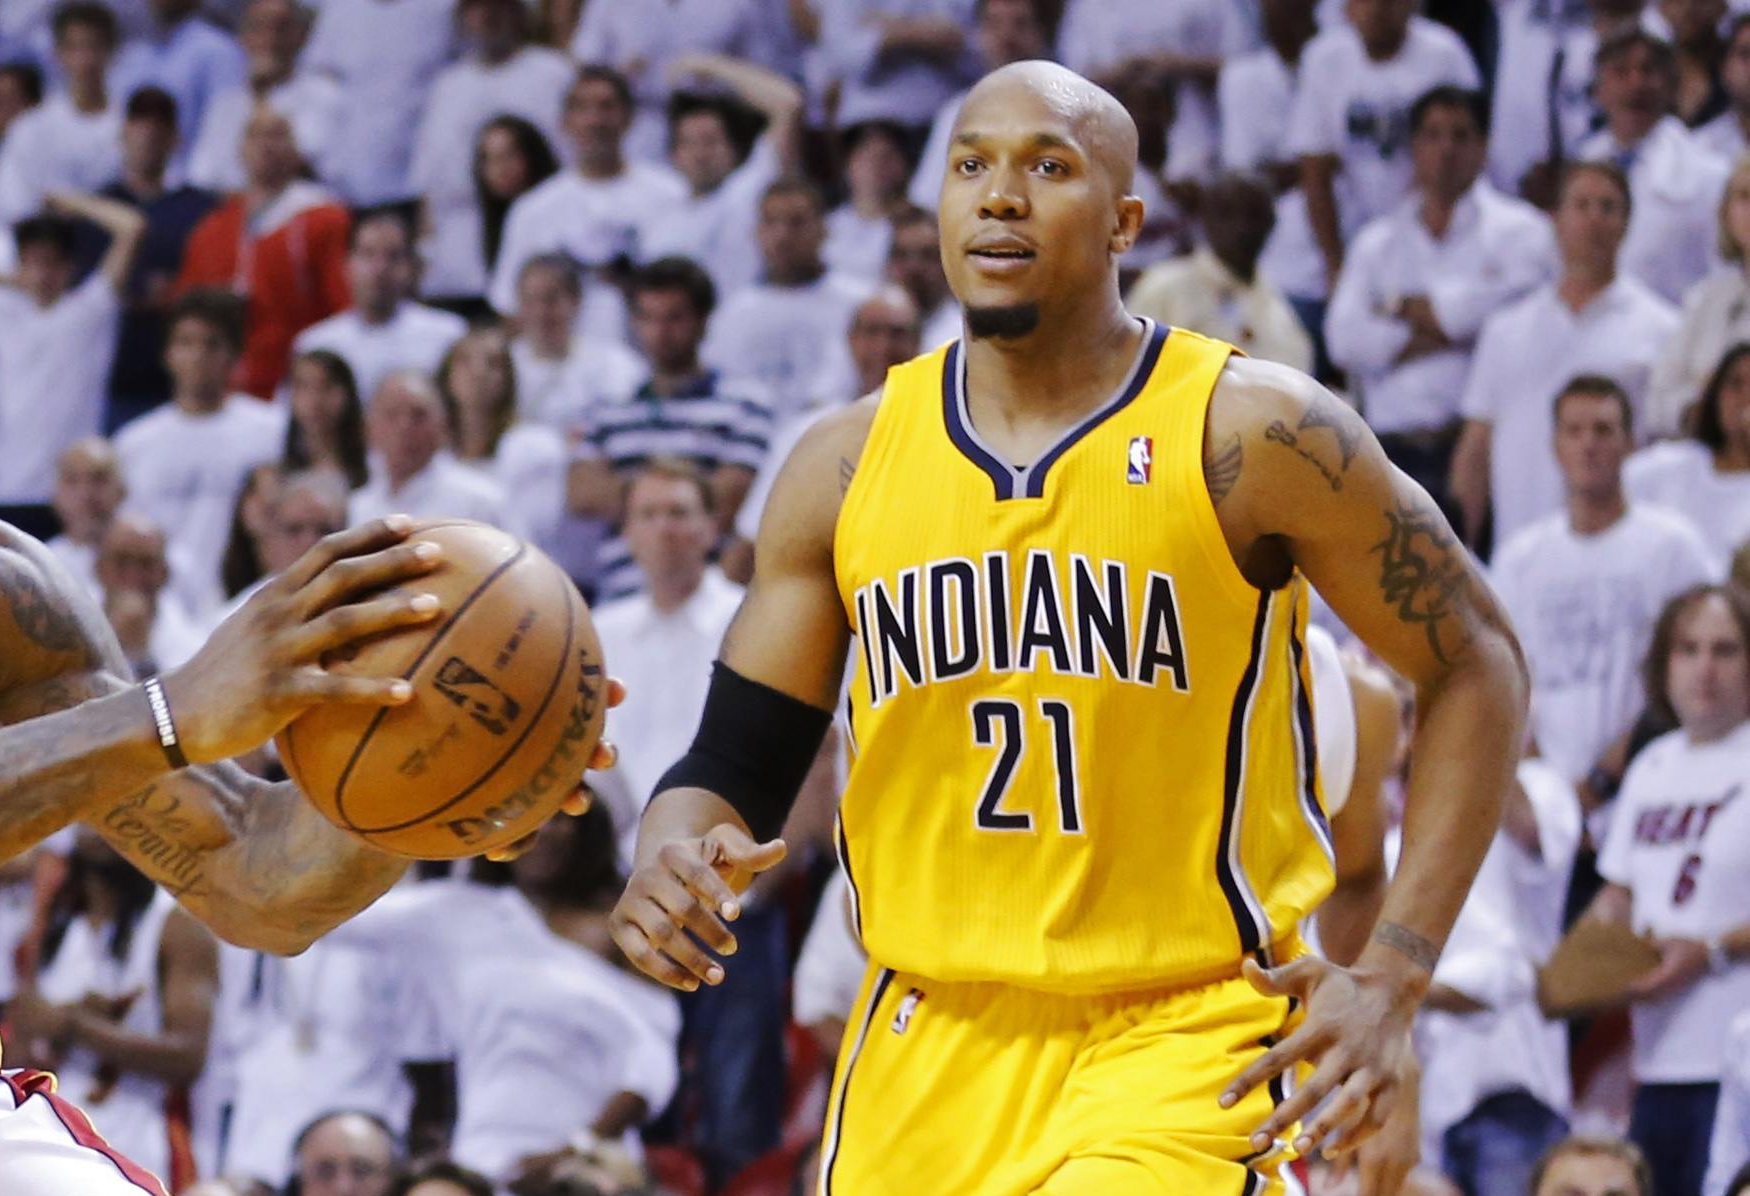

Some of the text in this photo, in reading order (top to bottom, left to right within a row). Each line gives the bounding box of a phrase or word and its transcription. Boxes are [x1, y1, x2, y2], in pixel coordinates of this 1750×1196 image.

[855, 549, 1190, 708] INDIANA
[970, 698, 1083, 834] 21
[1672, 853, 1703, 905] 6
